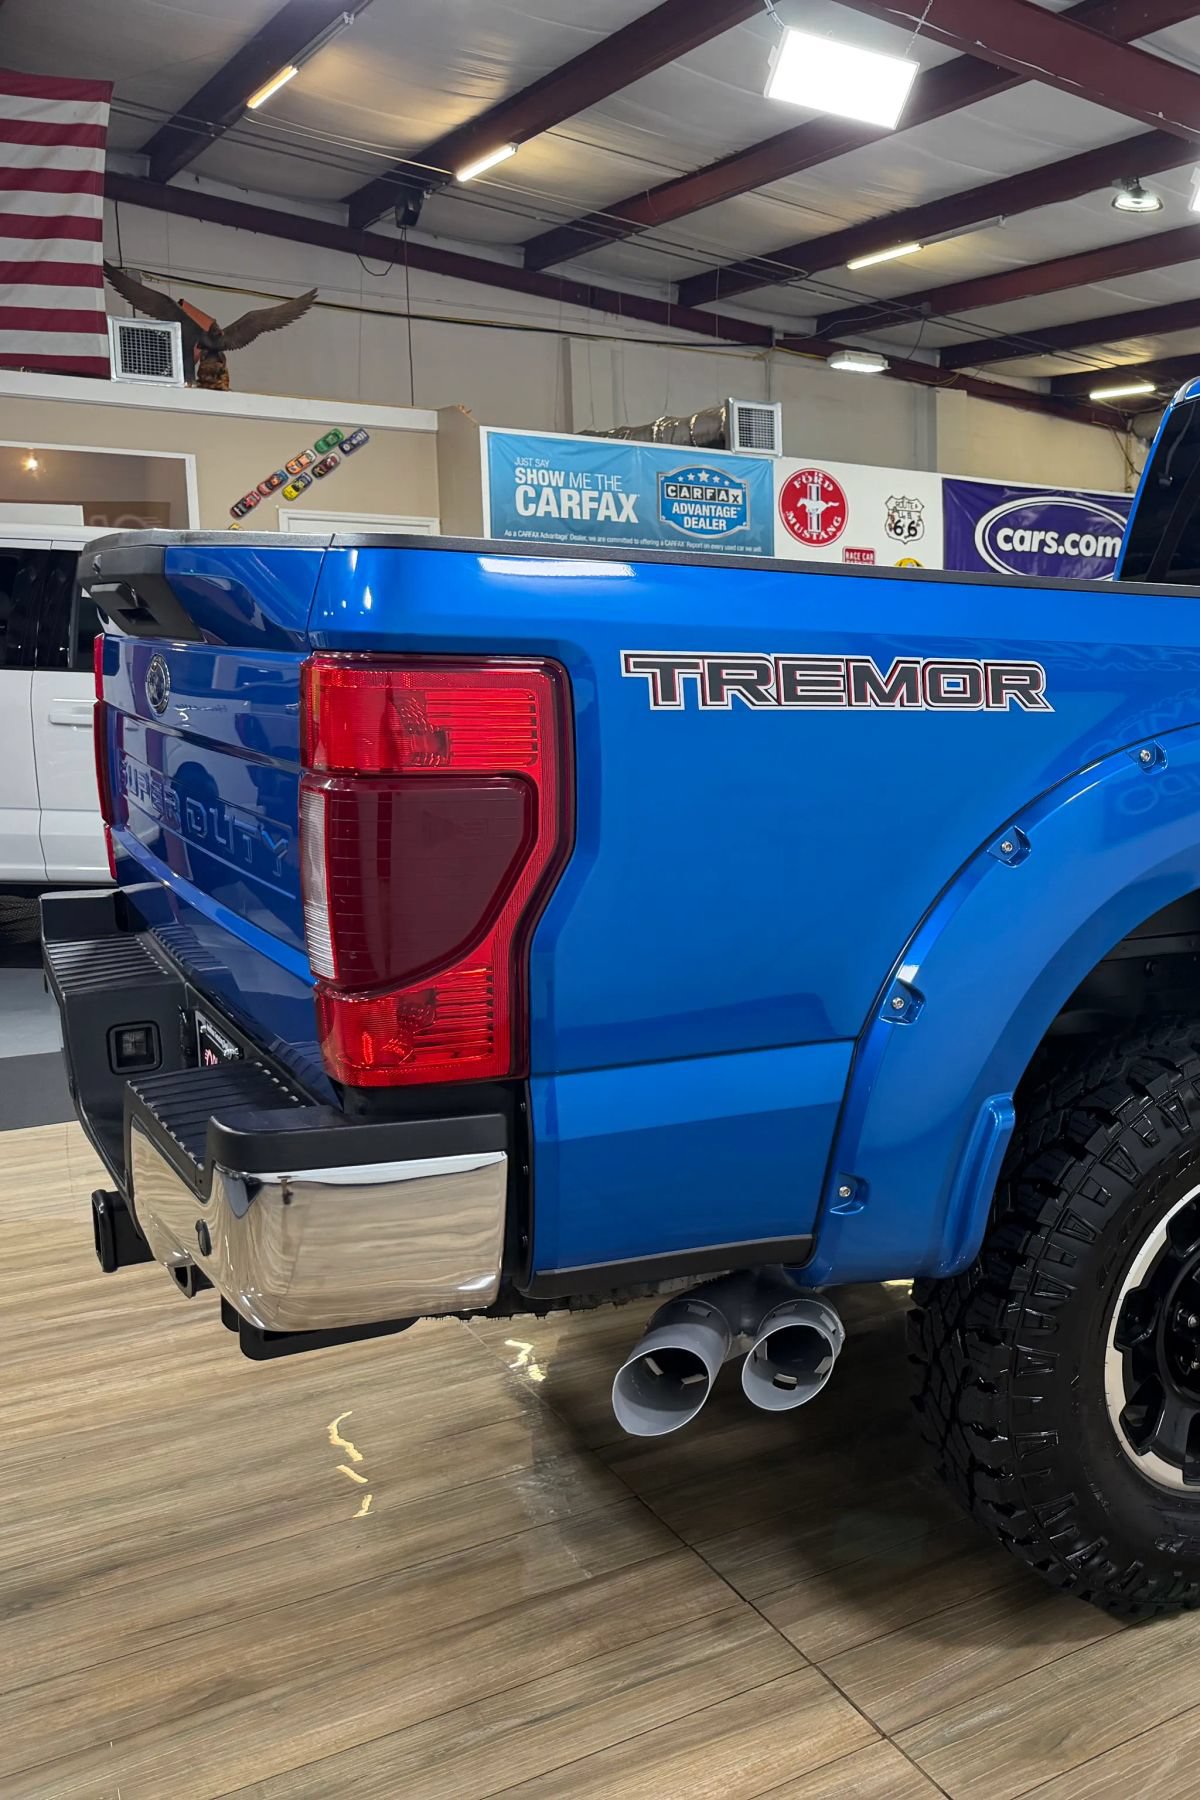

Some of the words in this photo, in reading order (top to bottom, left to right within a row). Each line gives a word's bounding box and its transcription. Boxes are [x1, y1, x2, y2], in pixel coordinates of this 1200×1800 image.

[514, 457, 532, 466] JUST
[535, 458, 550, 468] SAY
[514, 467, 566, 487] SHOW
[569, 472, 592, 489] ME
[594, 473, 623, 492] THE
[793, 472, 834, 491] FORD
[515, 484, 639, 524] CARFAX
[666, 485, 740, 504] CARFAX
[672, 502, 738, 518] ADVANTAGE
[684, 516, 727, 531] DEALER
[785, 510, 842, 540] MUSTANG
[894, 519, 918, 537] 66
[996, 527, 1123, 558] cars.com
[846, 551, 861, 561] RACE
[862, 553, 873, 561] CAR
[619, 649, 1056, 713] TREMOR
[186, 796, 289, 877] DUTY
